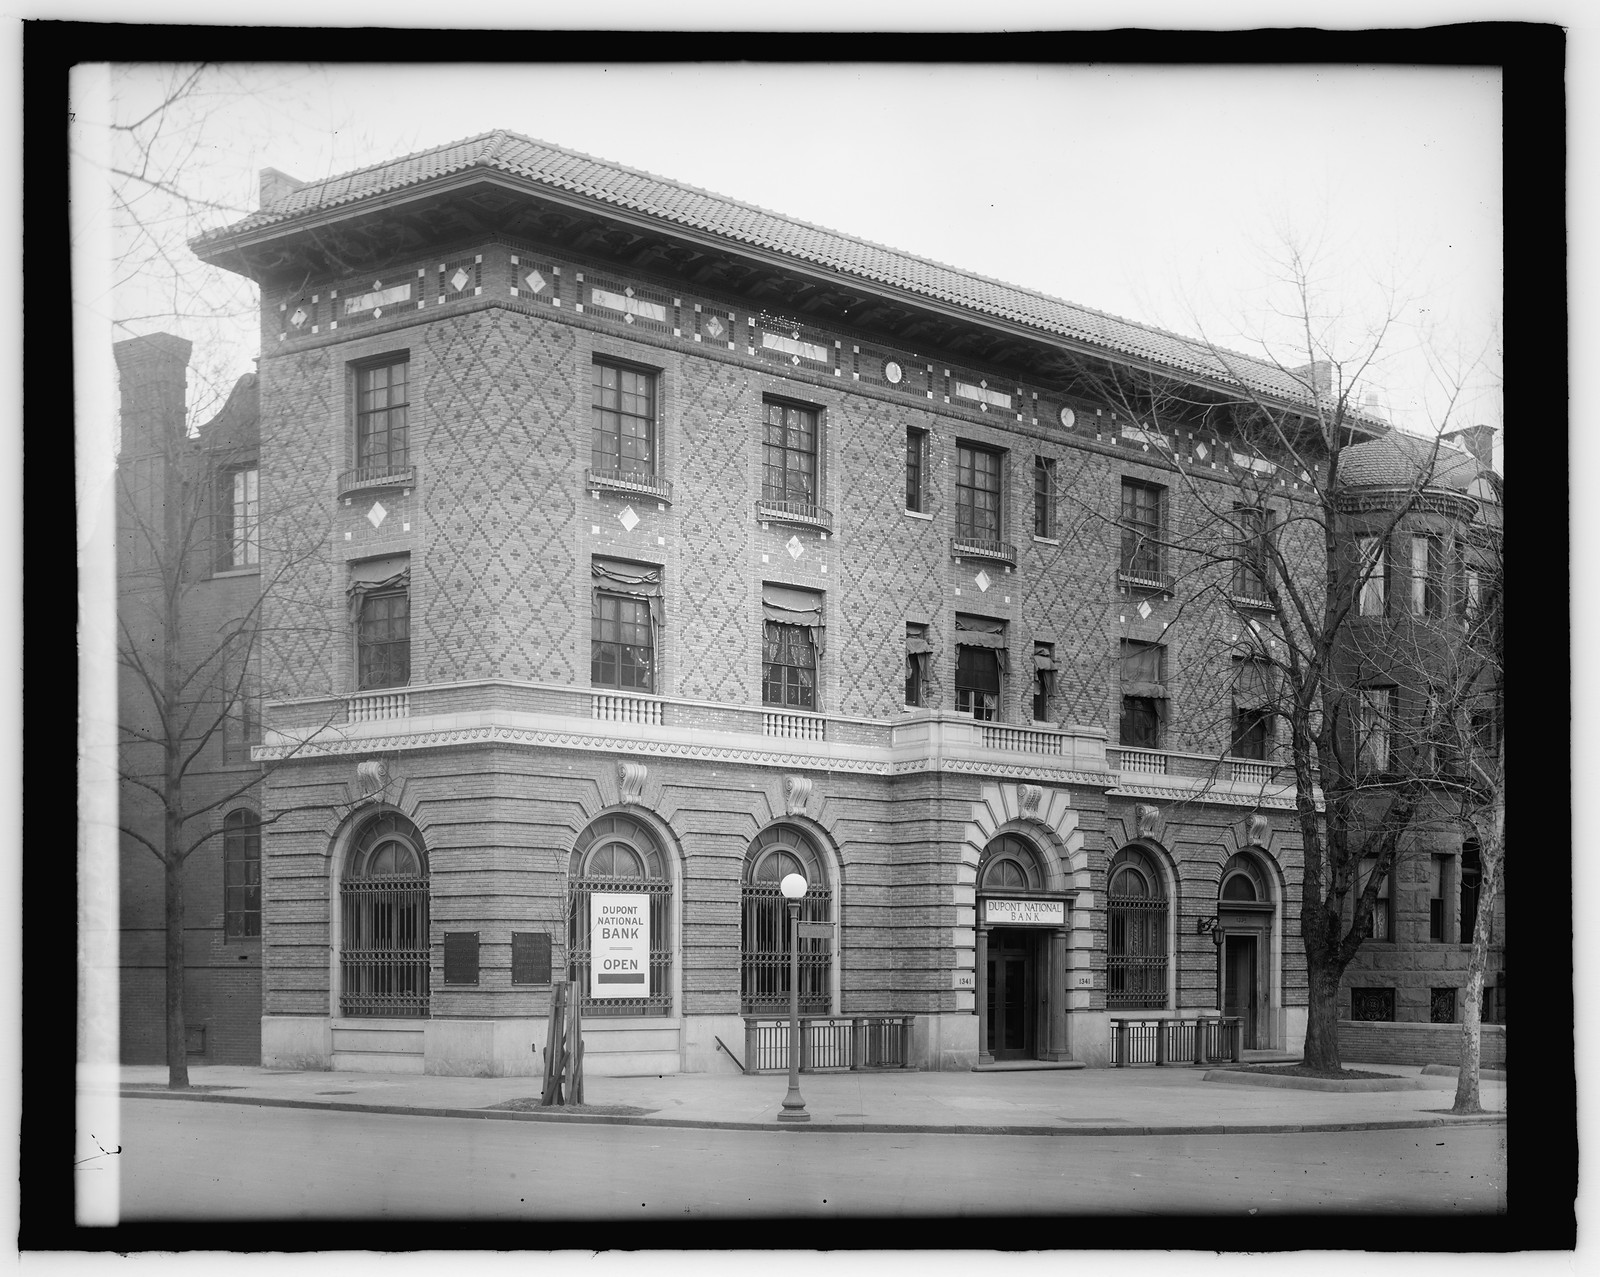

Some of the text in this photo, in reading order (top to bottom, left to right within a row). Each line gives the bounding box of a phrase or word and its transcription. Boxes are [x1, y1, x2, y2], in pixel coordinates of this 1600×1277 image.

[602, 905, 638, 915] DUPONT
[988, 901, 1062, 913] DUPONT NATIONAL
[597, 916, 644, 926] NATIONAL
[1011, 912, 1040, 922] BANK
[602, 927, 639, 939] BANK
[603, 958, 638, 970] OPEN
[959, 977, 972, 985] 1341
[1078, 977, 1091, 985] 1341
